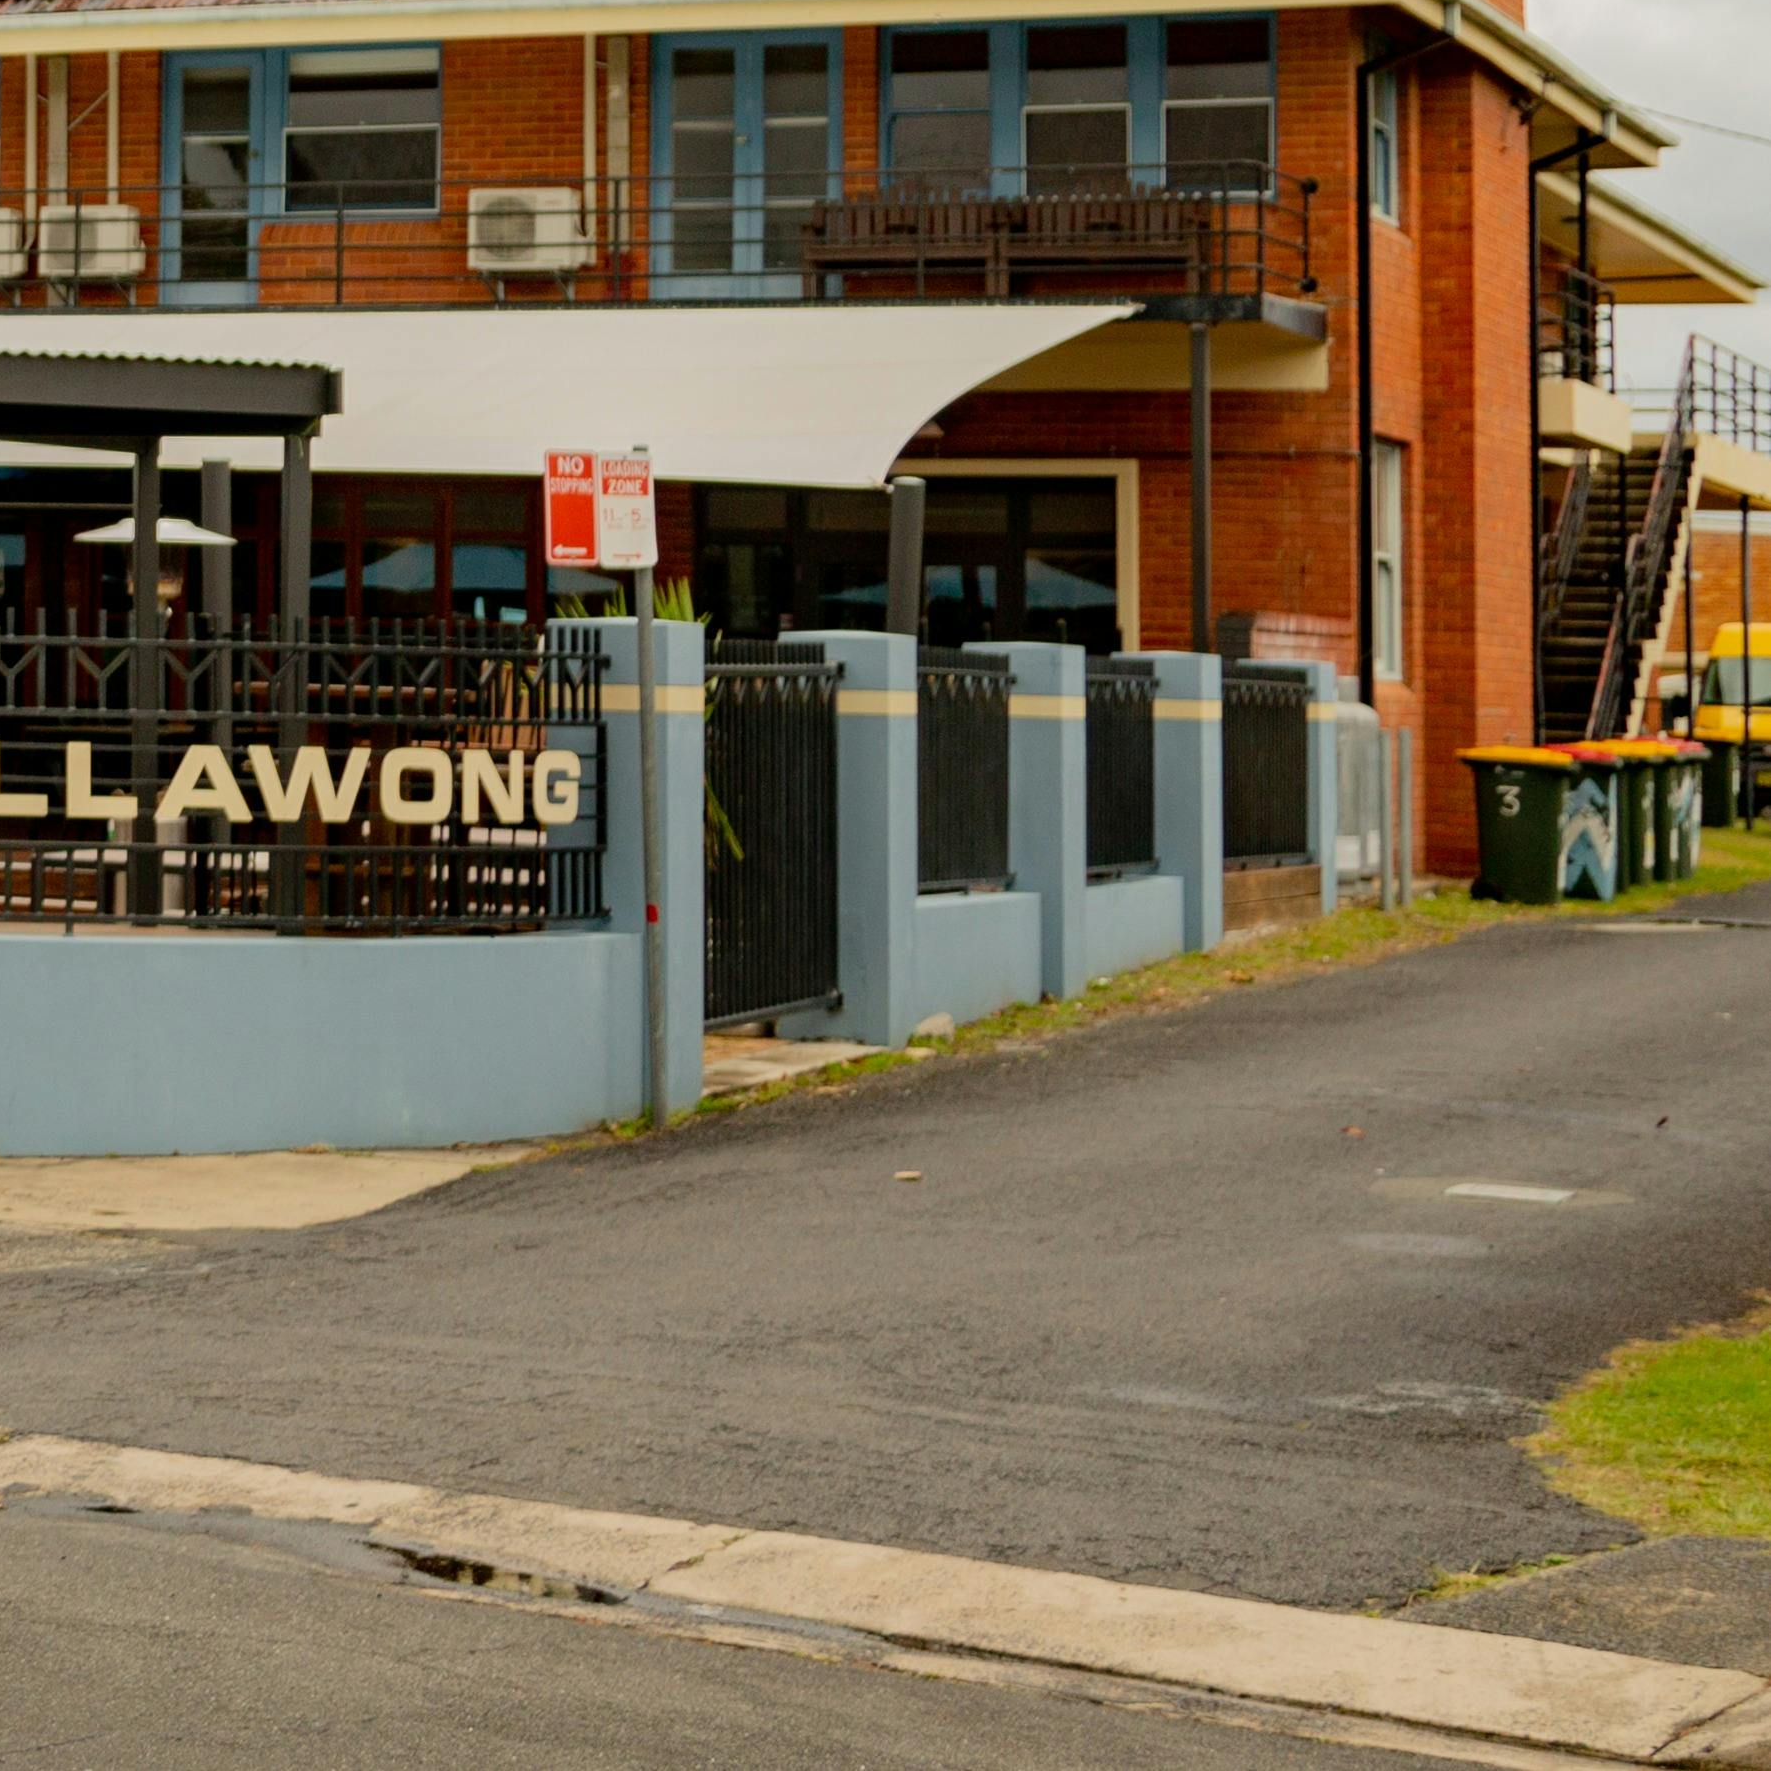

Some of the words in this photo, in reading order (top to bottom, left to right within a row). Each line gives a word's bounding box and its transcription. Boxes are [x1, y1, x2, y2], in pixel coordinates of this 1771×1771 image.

[557, 455, 585, 476] NO
[603, 461, 649, 476] LOADING
[550, 478, 594, 494] STOPPING
[608, 478, 643, 494] ZONE
[1496, 784, 1521, 817] 3
